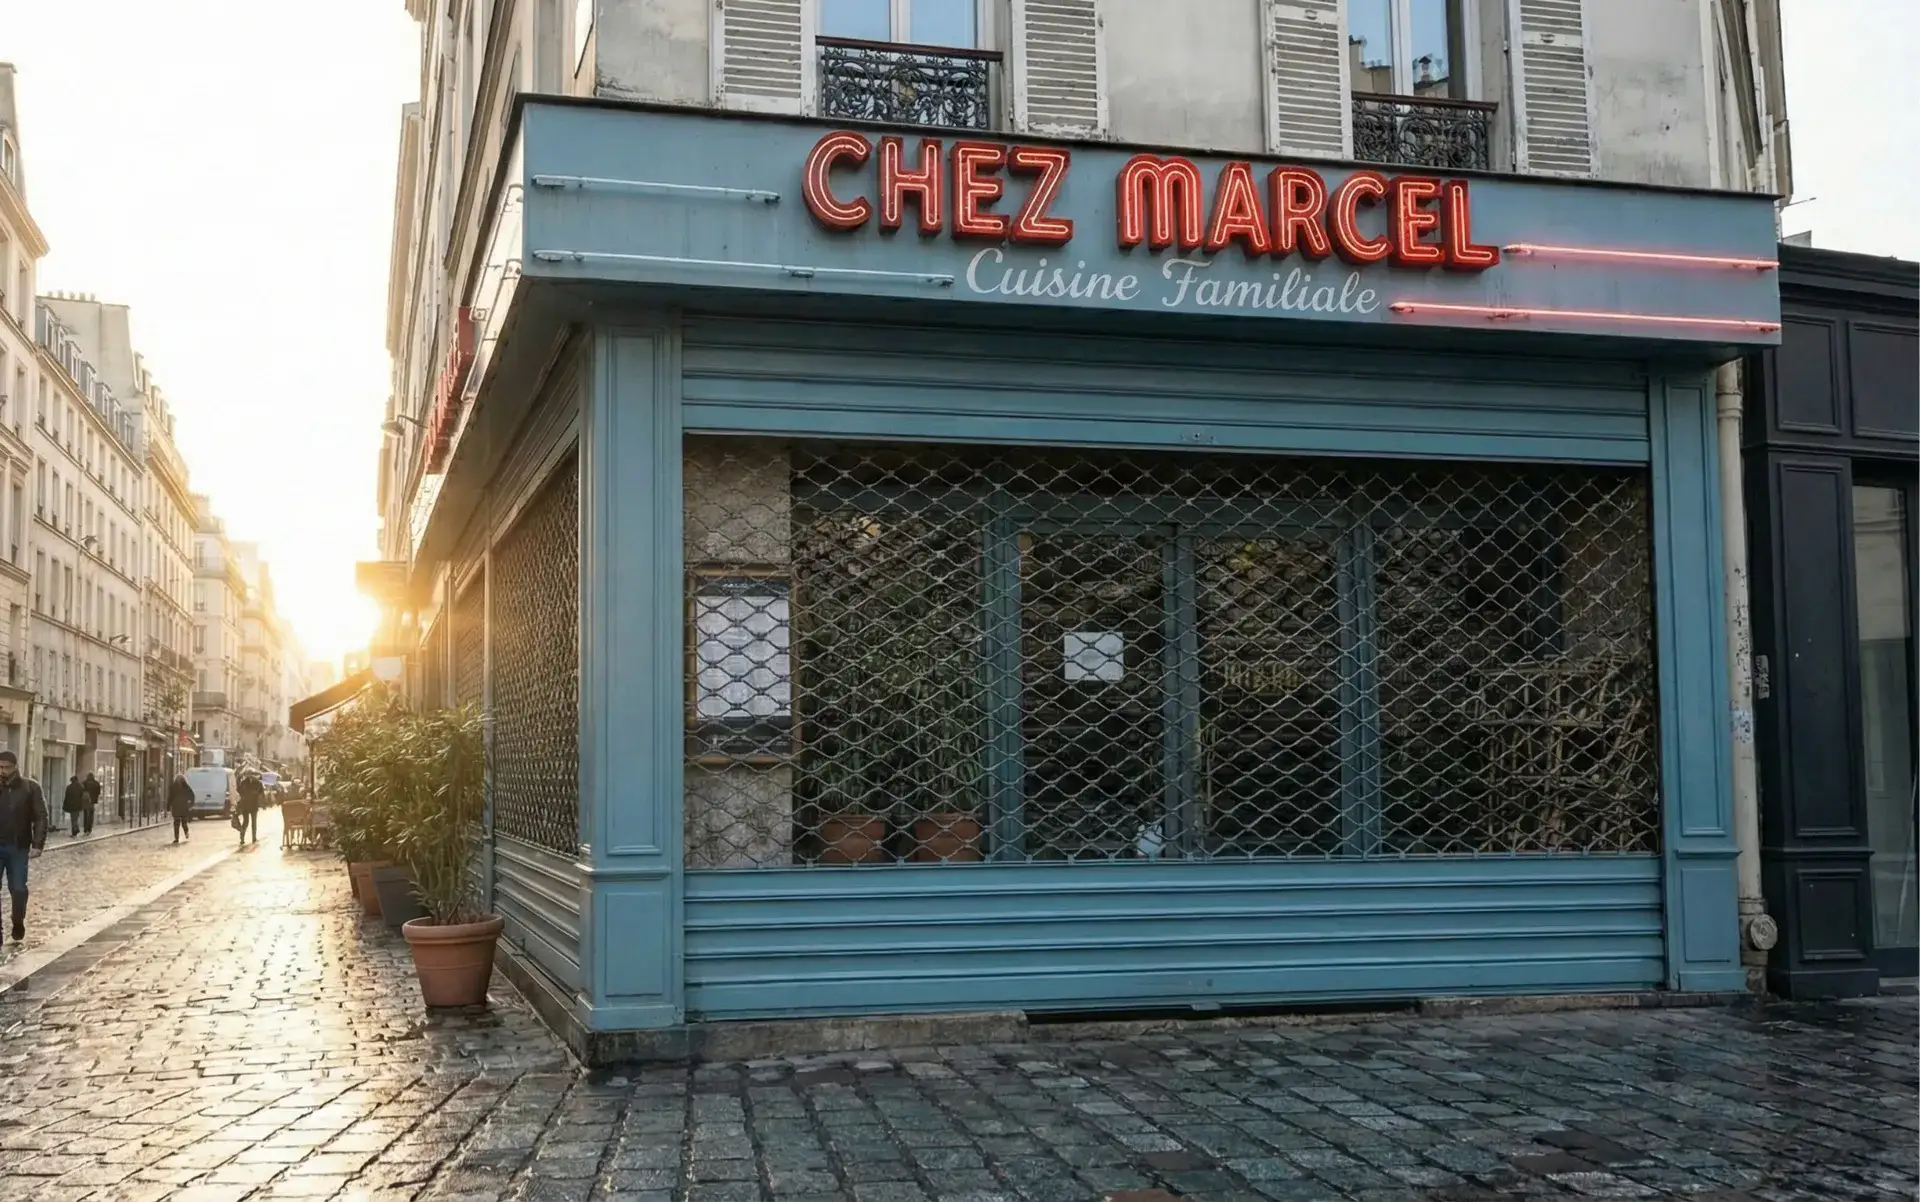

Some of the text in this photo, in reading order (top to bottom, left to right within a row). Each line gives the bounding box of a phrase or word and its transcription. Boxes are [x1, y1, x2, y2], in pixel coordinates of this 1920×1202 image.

[803, 131, 1500, 271] CHEZ MARCEL
[966, 248, 1381, 314] Cuisine Familiale
